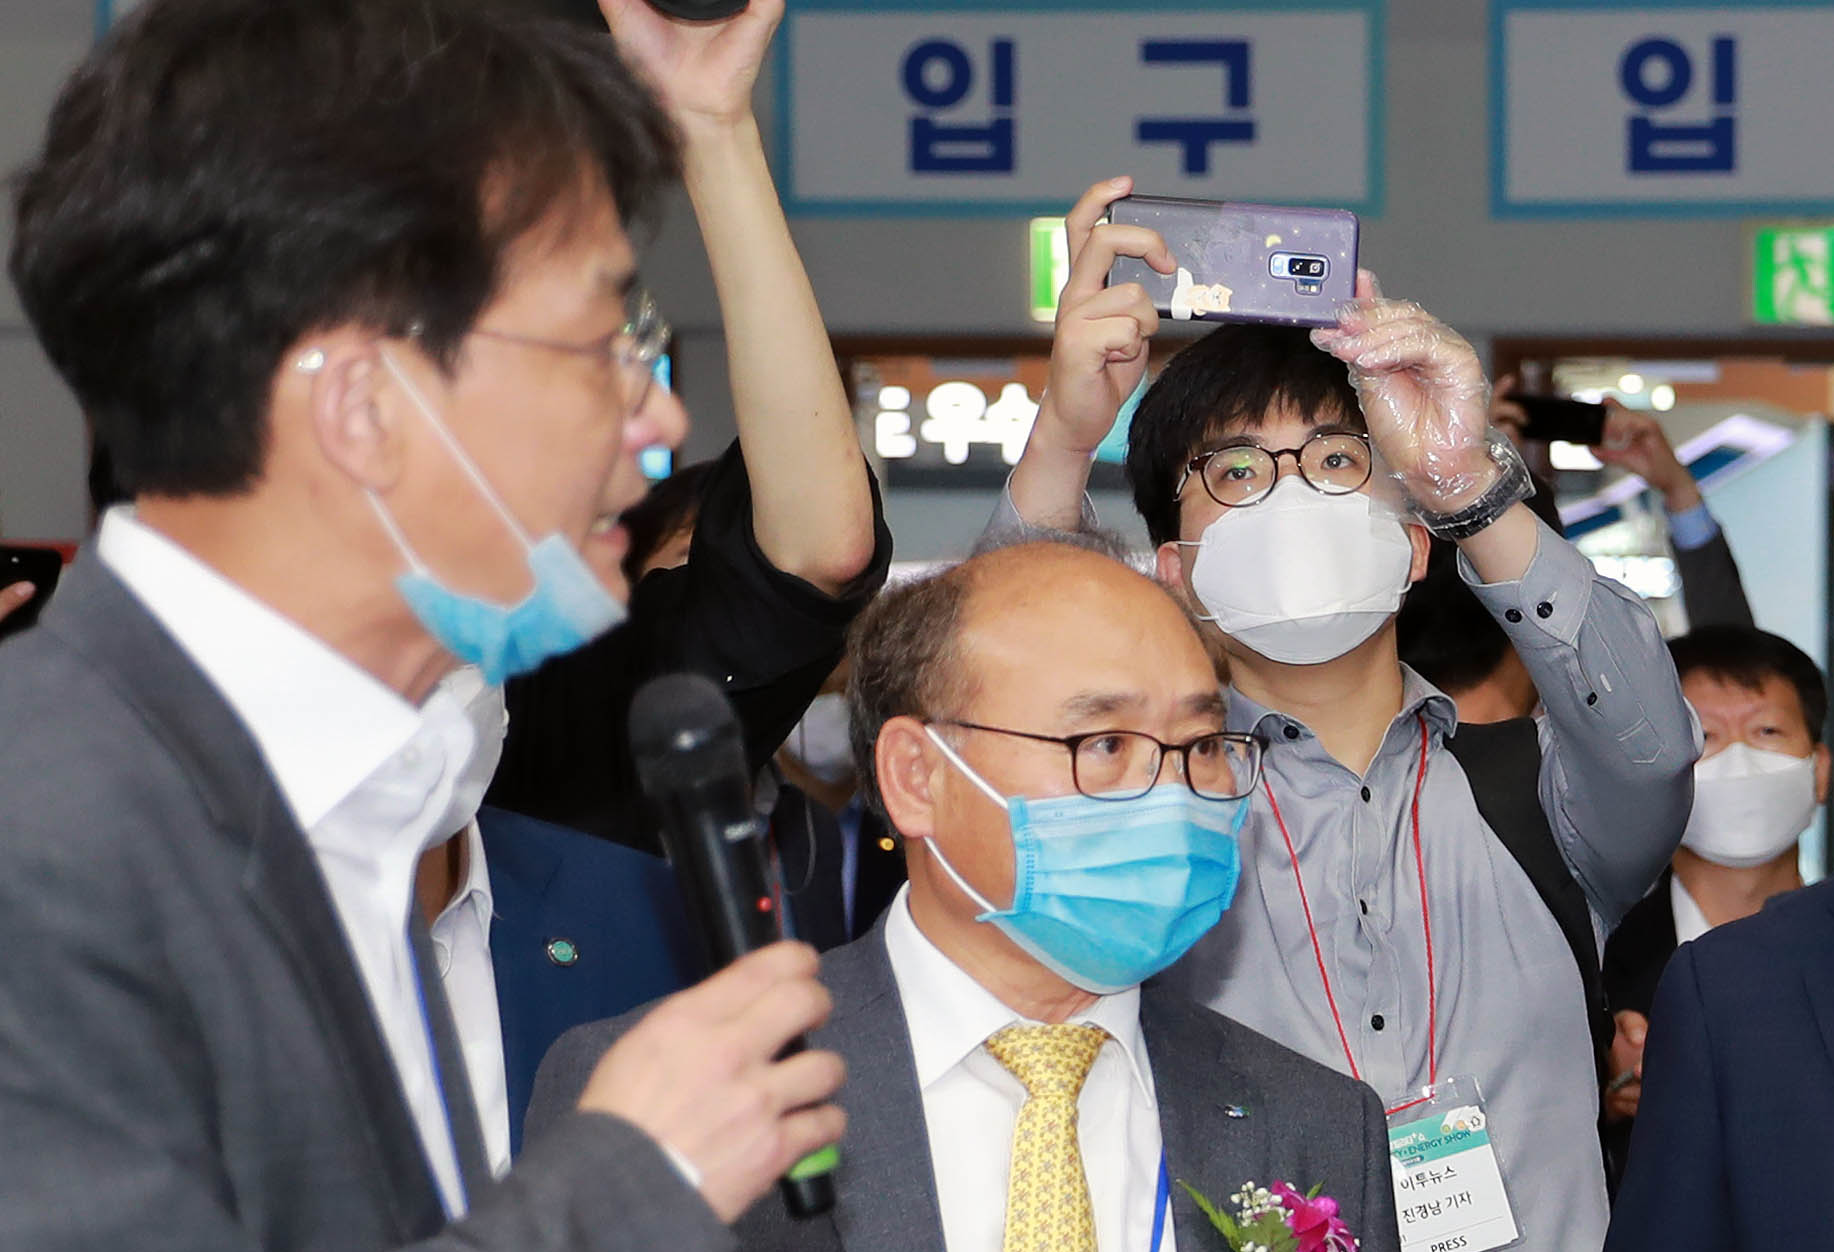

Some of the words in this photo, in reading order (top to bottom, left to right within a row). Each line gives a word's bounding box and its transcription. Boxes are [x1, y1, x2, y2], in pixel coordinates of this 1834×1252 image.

[901, 35, 1256, 176] 입구
[1400, 1165, 1458, 1191] 이투뉴스
[1402, 1200, 1442, 1224] 진경남
[1446, 1190, 1473, 1210] 기자
